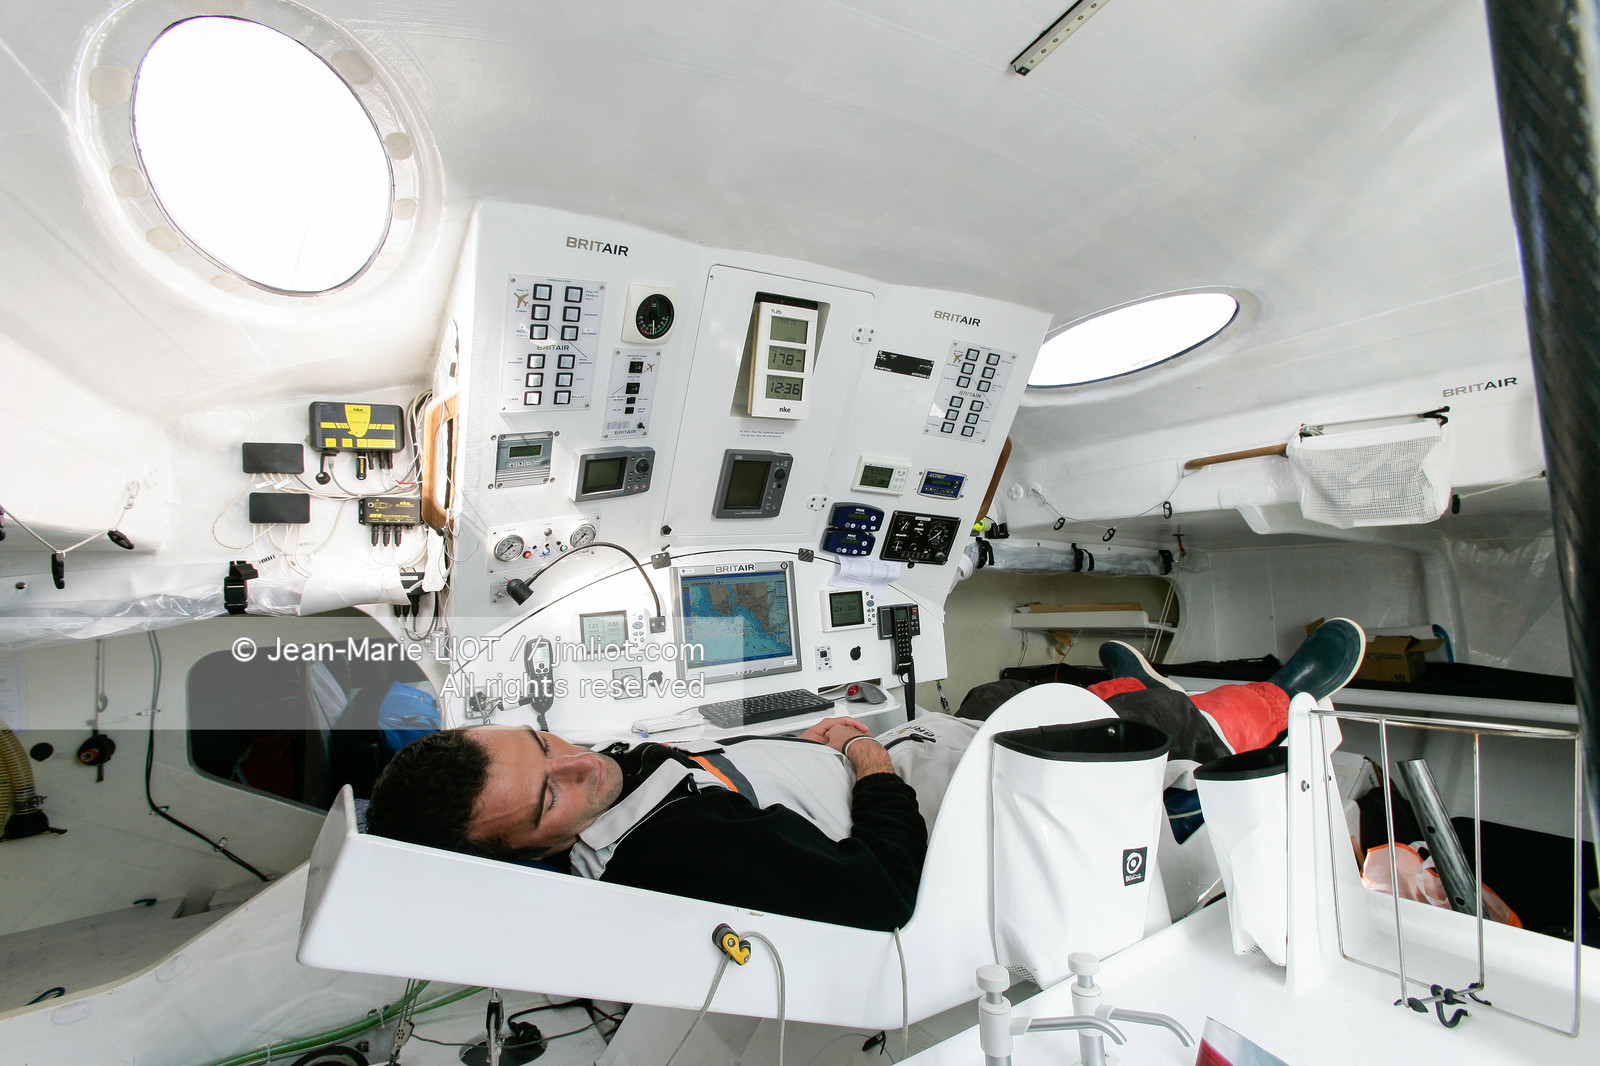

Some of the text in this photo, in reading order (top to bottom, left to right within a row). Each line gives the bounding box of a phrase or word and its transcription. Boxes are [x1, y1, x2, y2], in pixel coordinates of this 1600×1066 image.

[565, 236, 629, 257] BRITAIR
[933, 309, 981, 327] BRITAIR
[770, 381, 800, 395] 12:36
[1442, 377, 1518, 398] BRITAIR
[715, 564, 755, 573] BRITAIR
